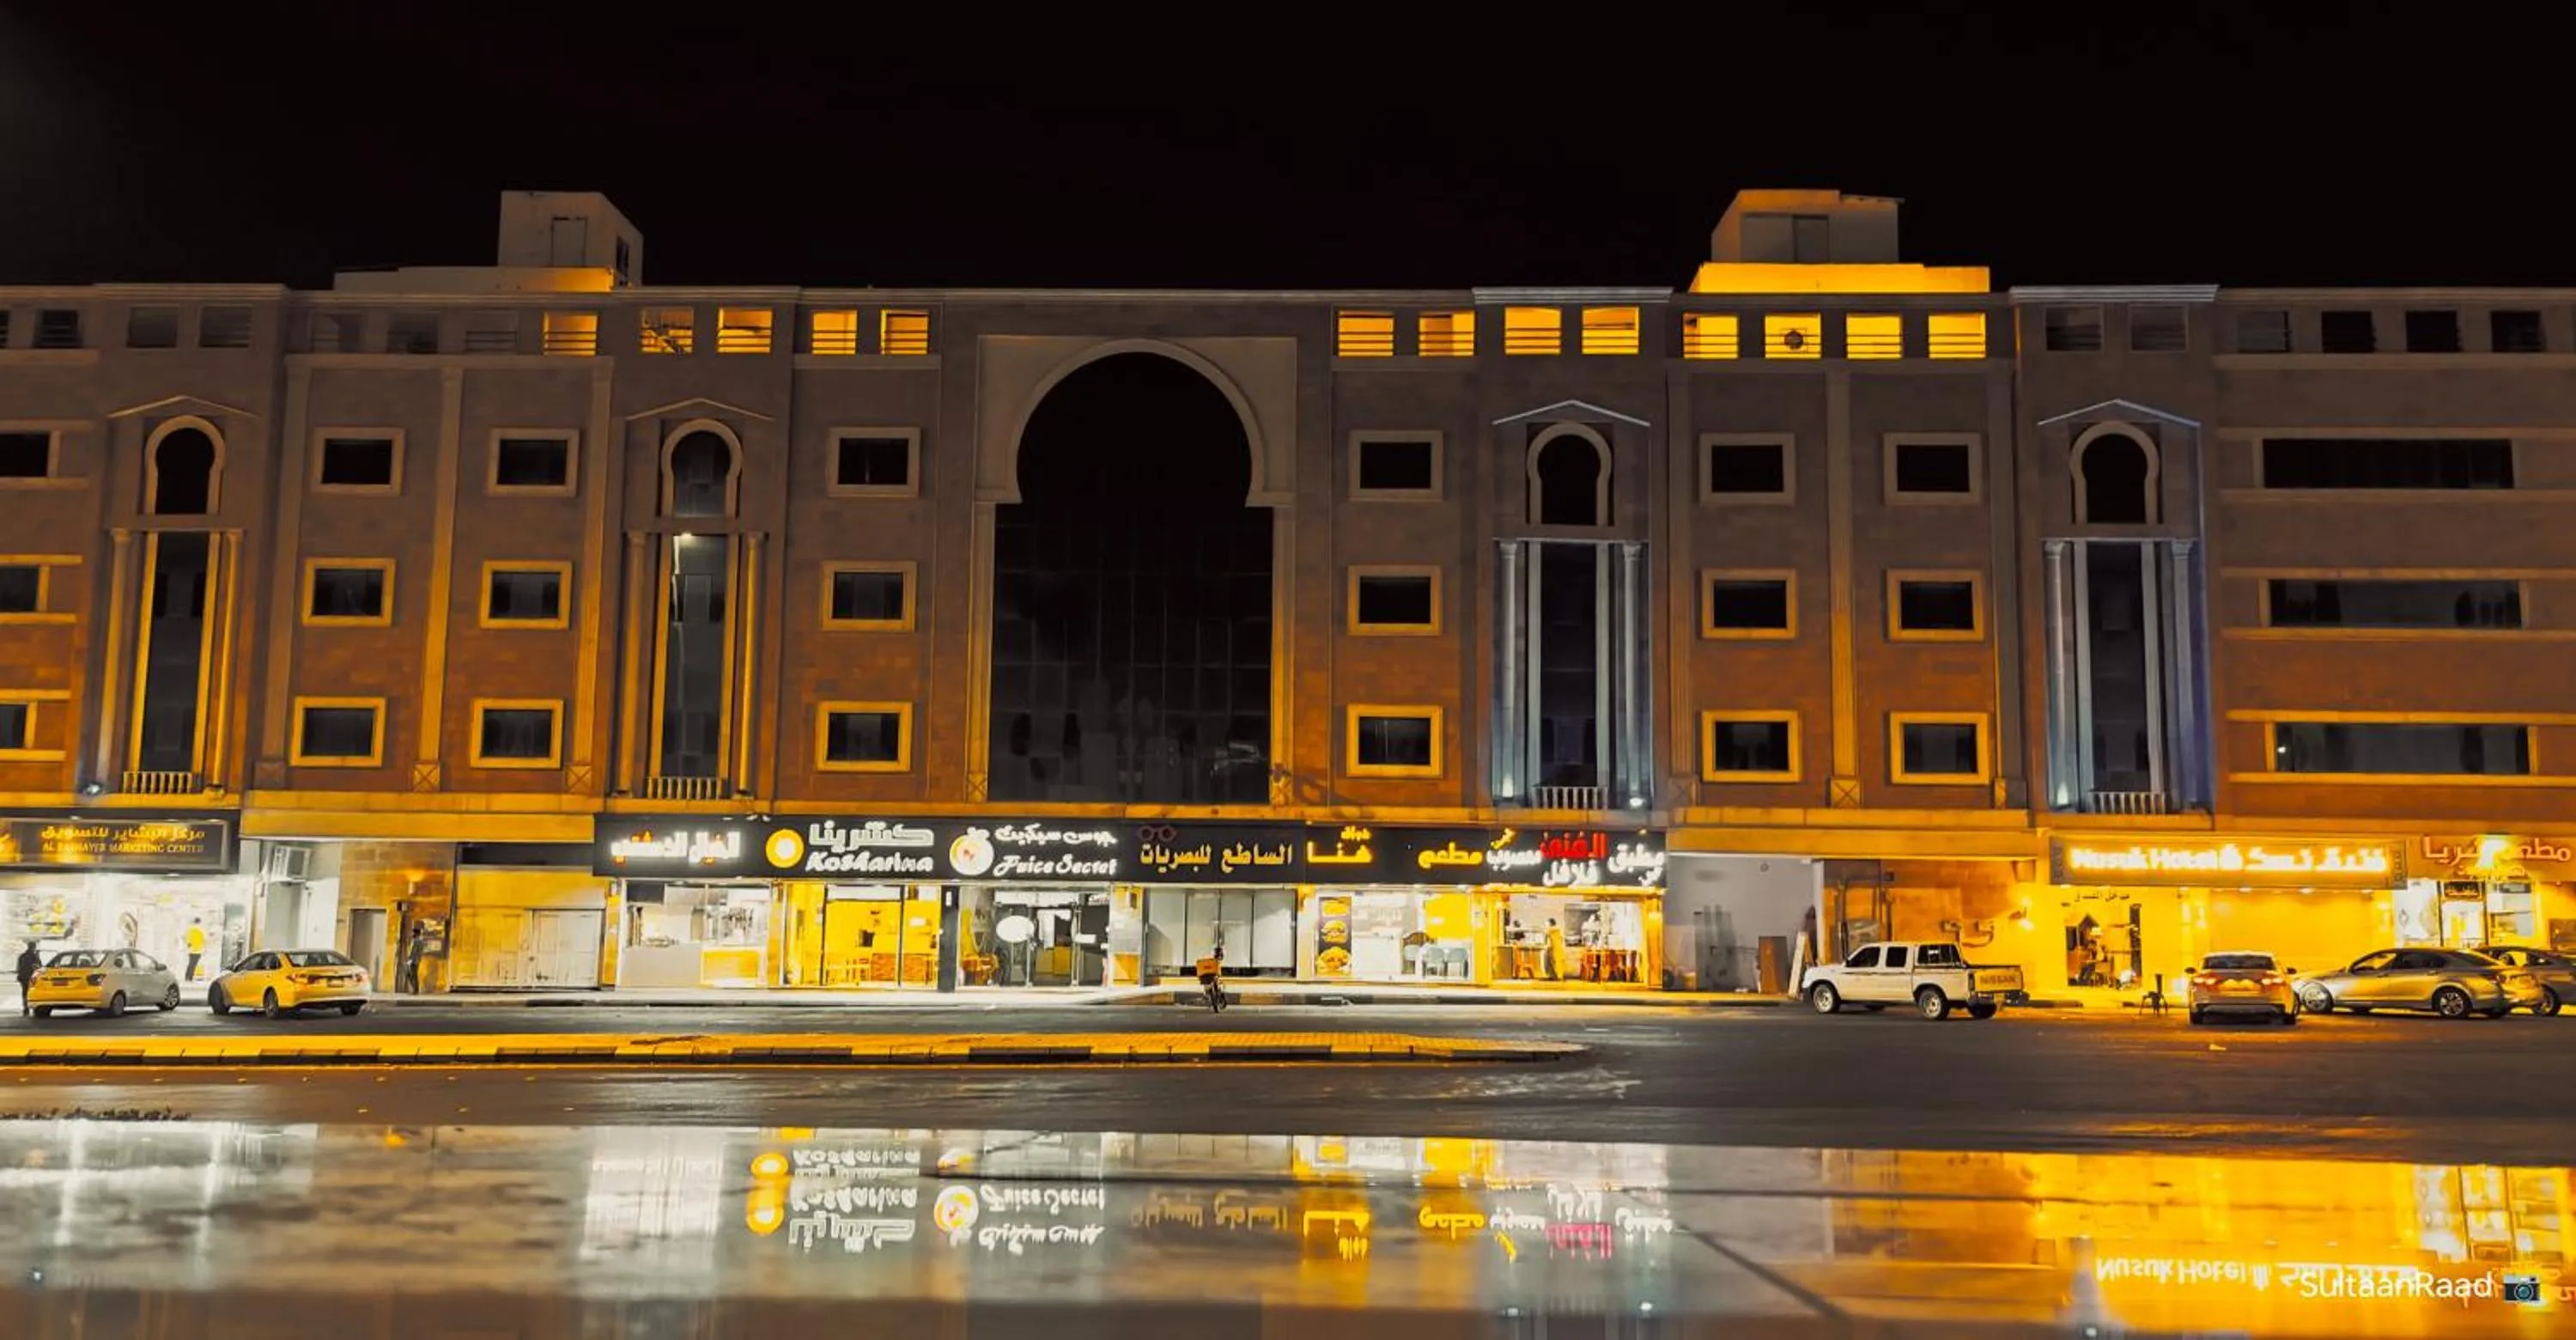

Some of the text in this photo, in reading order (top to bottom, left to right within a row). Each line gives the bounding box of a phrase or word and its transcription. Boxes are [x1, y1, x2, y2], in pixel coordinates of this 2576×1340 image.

[110, 842, 166, 854] MARKETING
[167, 843, 204, 853] CENTER
[1139, 842, 1293, 874] الساطع للبصريات
[1418, 842, 1484, 869] مطعم
[2150, 847, 2218, 869] Hotel
[805, 851, 933, 873] Kosharina
[1055, 853, 1117, 874] Secret
[1542, 858, 1601, 887] فلافل
[1979, 974, 2017, 985] NISSAN
